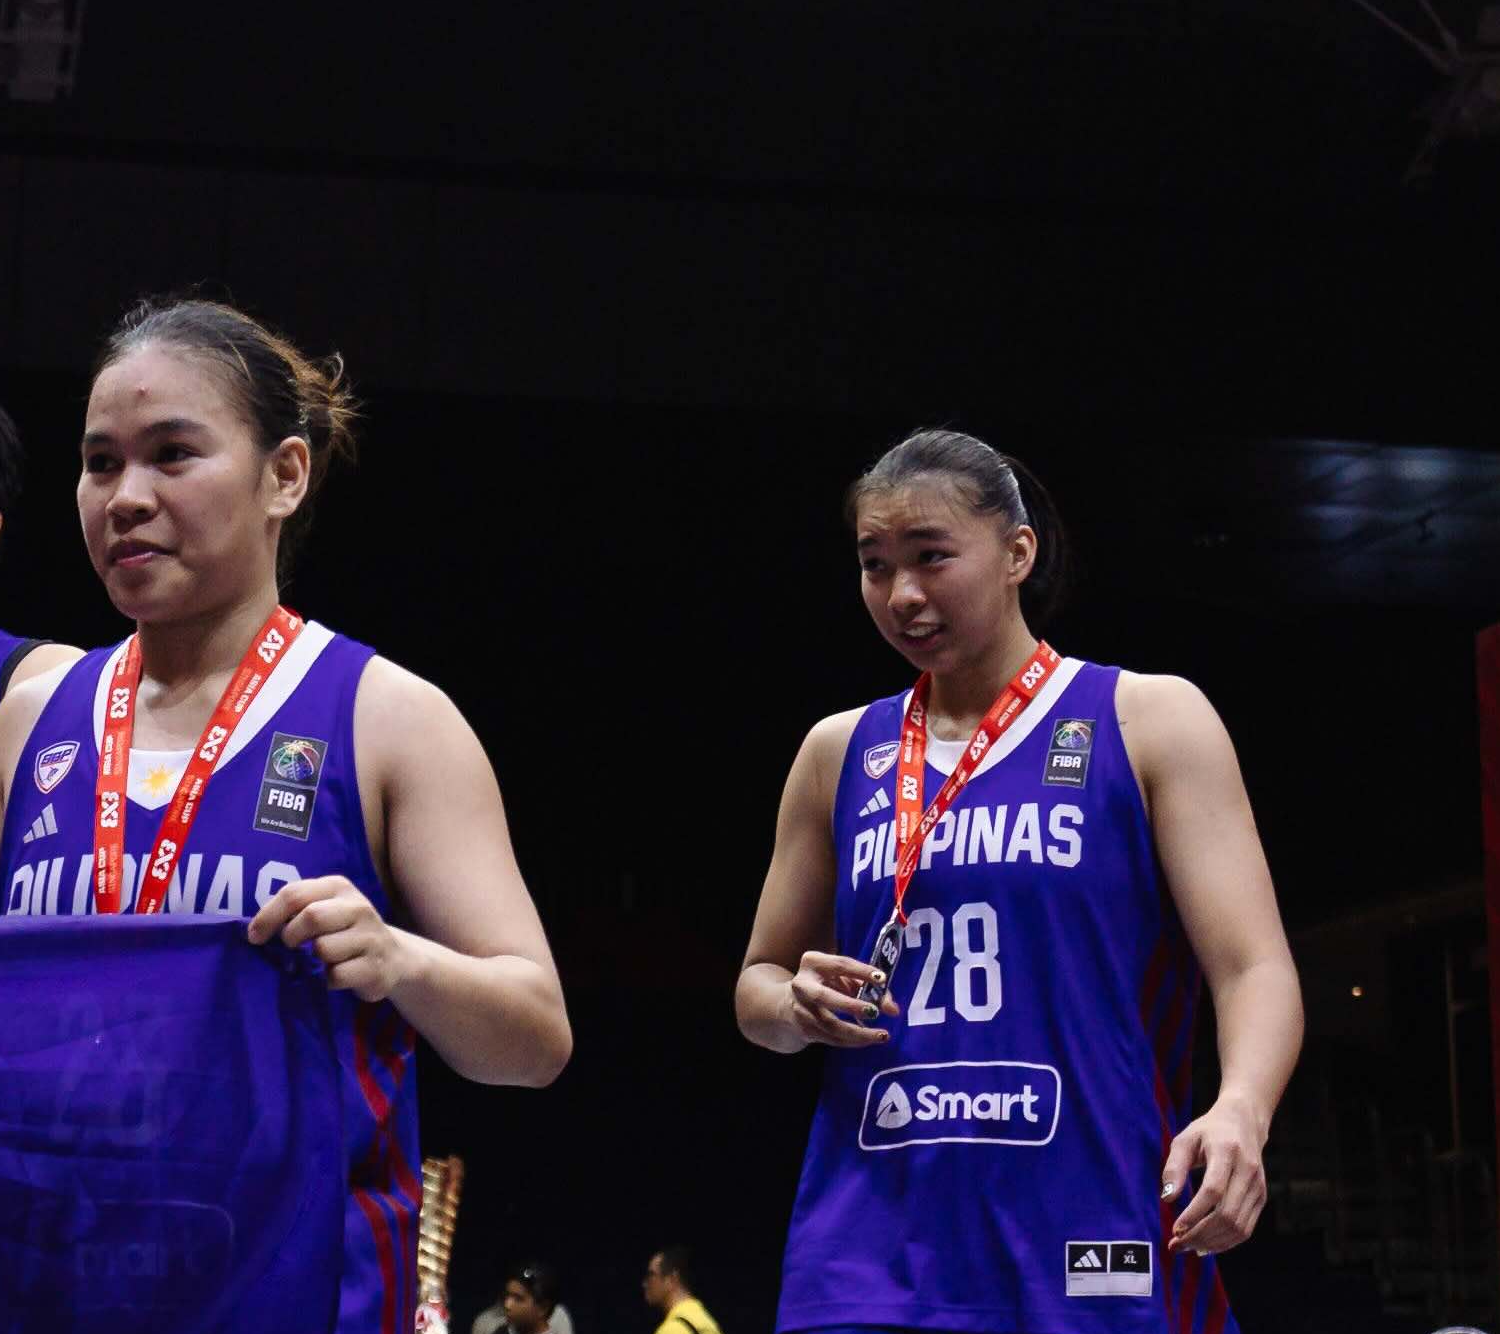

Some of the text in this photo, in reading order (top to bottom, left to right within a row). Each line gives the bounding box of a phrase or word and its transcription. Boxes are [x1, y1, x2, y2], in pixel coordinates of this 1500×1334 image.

[1052, 755, 1082, 769] FIBA
[267, 788, 307, 812] FIBA
[852, 803, 1085, 892] PILPINAS
[905, 902, 1002, 1027] 28
[914, 1079, 1039, 1126] Smart
[1123, 1254, 1137, 1264] XL
